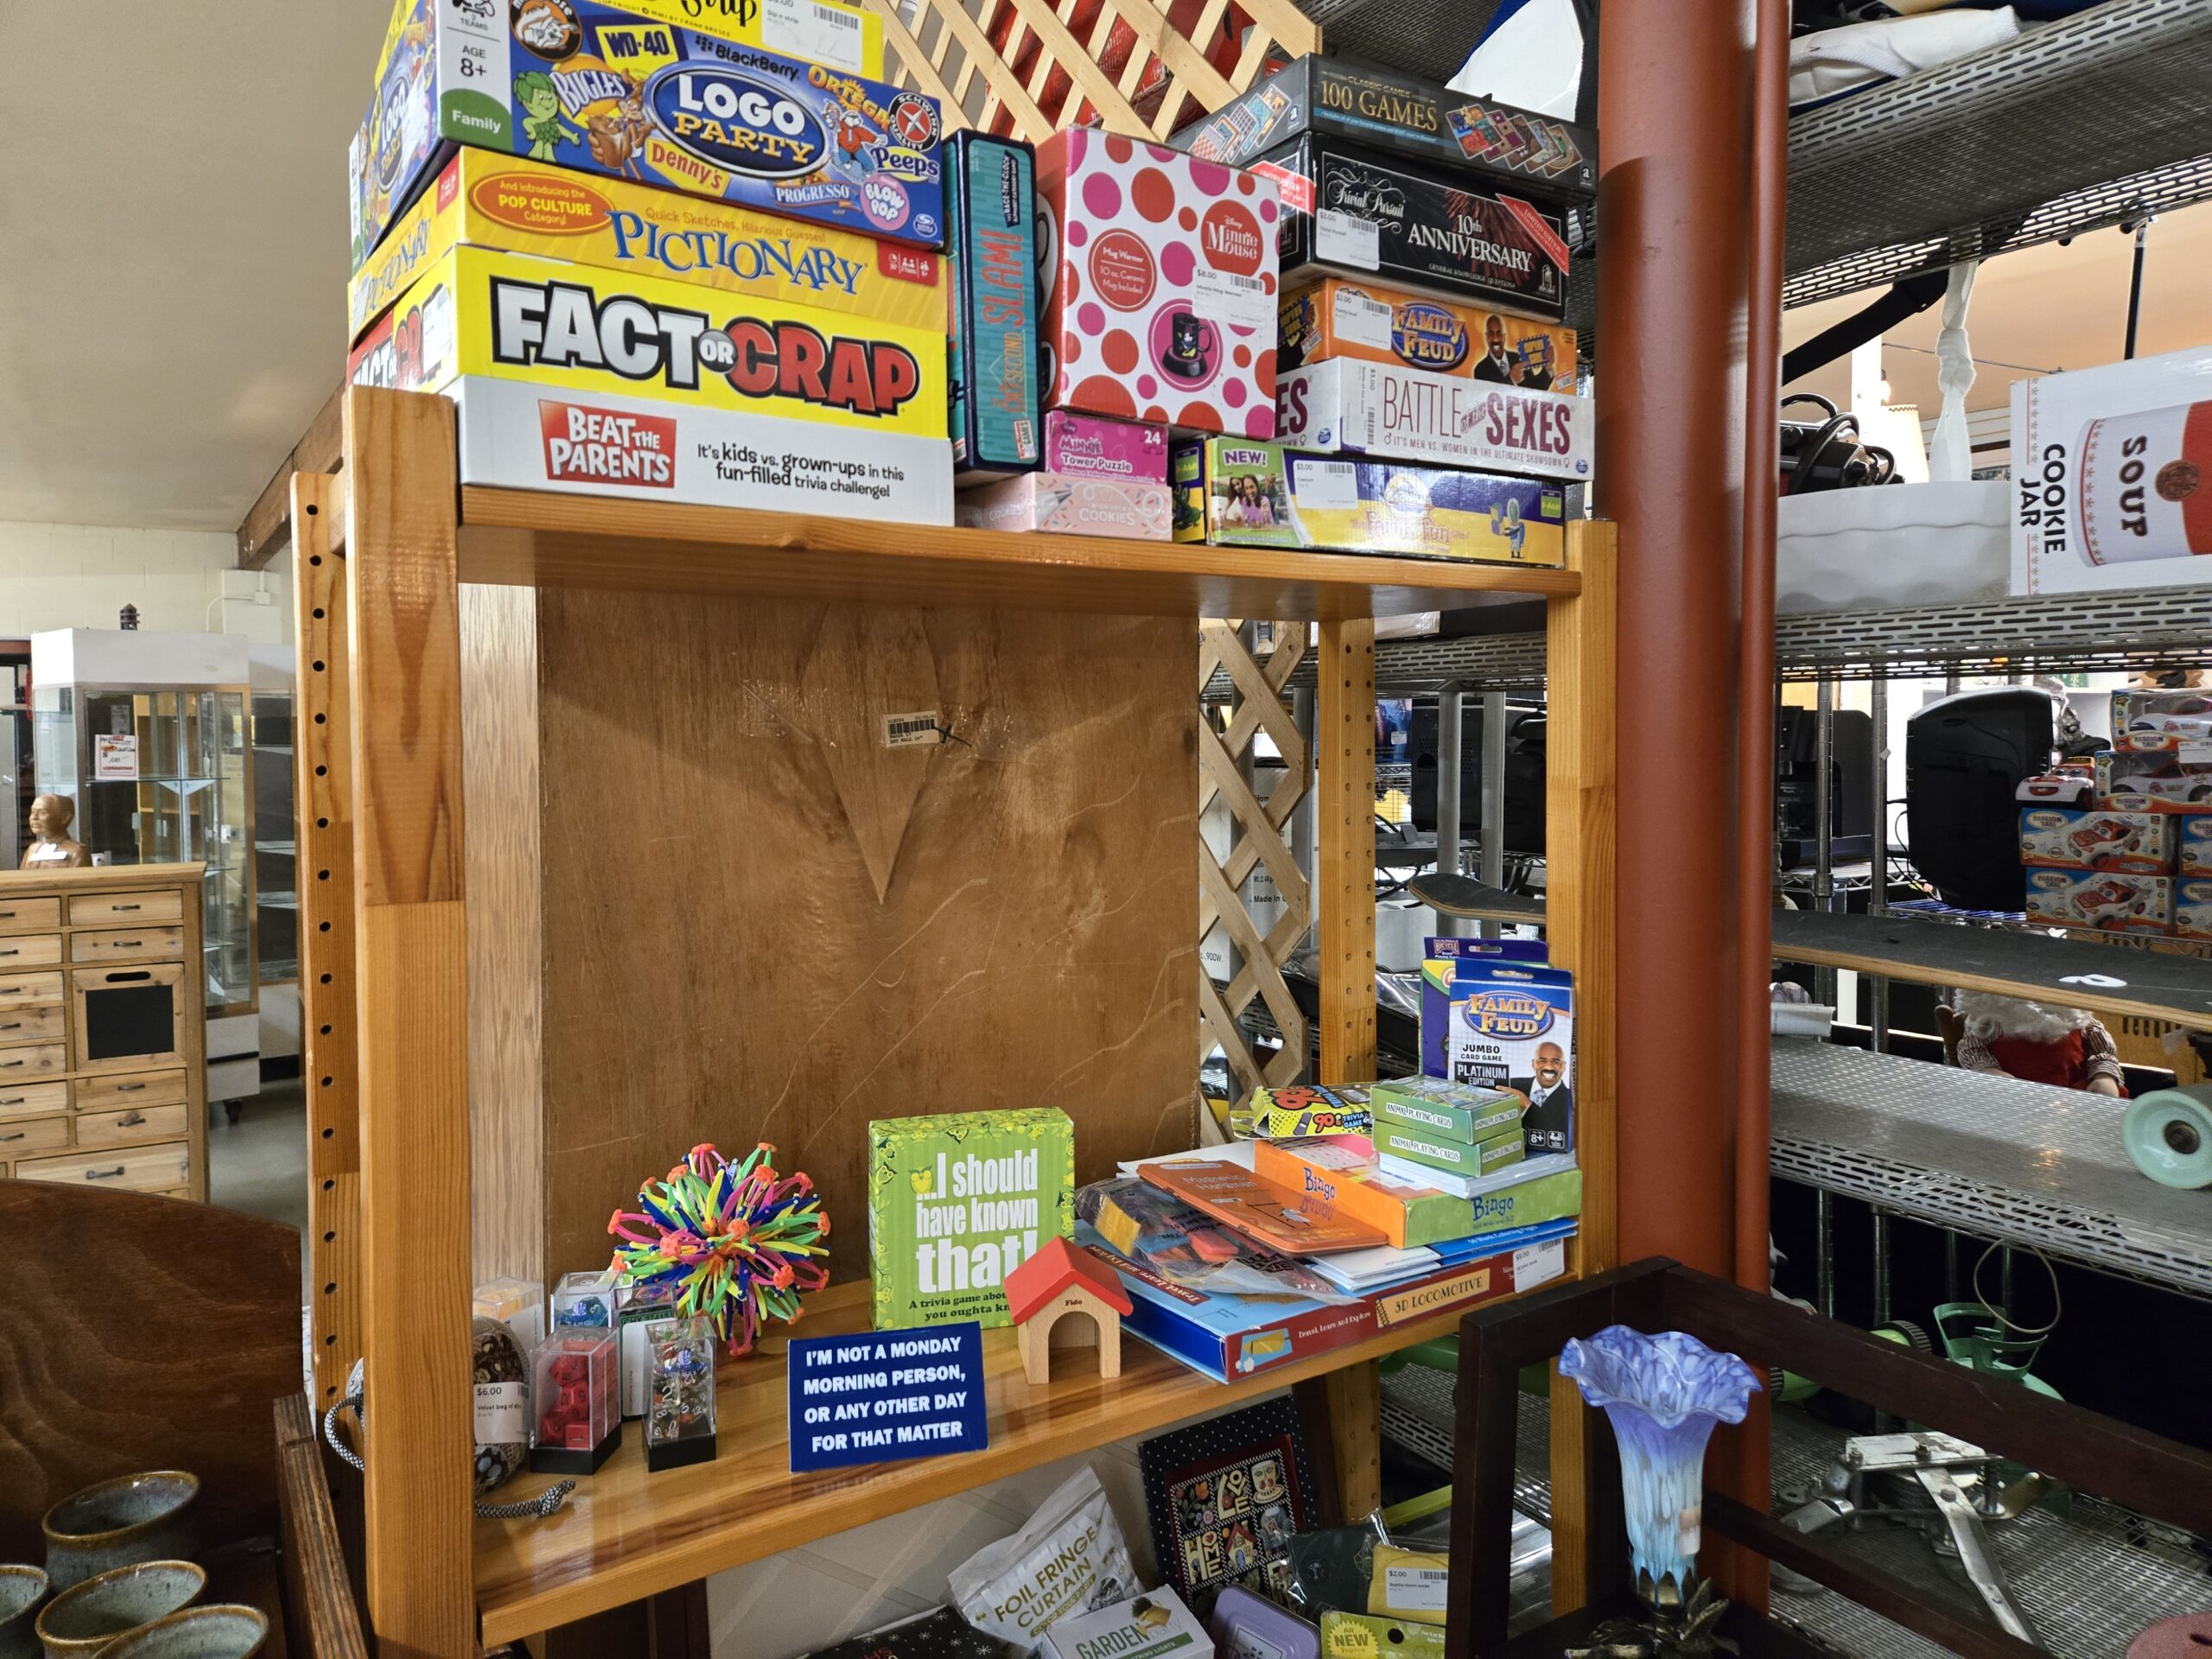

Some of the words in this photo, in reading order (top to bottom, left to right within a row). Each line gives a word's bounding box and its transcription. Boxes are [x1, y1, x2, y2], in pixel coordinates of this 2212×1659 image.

[460, 17, 488, 31] TEAMS
[462, 45, 486, 59] AGE
[604, 30, 672, 58] WD-40
[461, 58, 487, 78] 8+
[715, 44, 799, 81] BlackBerry
[549, 69, 626, 118] BUGLES
[679, 73, 805, 136] LOGO
[808, 65, 891, 131] ORTEGA
[1321, 79, 1353, 111] 100
[1358, 90, 1438, 131] GAMES
[452, 110, 501, 135] Family
[898, 92, 938, 137] SCHWINN
[672, 111, 815, 164] PARTY
[890, 113, 925, 151] QUALITY
[652, 142, 723, 190] Denny's
[869, 146, 941, 176] Peeps
[499, 180, 517, 192] And
[519, 182, 569, 199] Introducing
[571, 188, 586, 199] the
[776, 183, 850, 204] PROGRESSO
[865, 182, 906, 208] BLOW
[1327, 179, 1368, 208] Trivial
[1367, 188, 1406, 219] Pursuit
[498, 194, 528, 208] POP
[531, 198, 593, 216] CULTURE
[524, 211, 567, 226] Category!
[871, 200, 899, 222] POP
[645, 207, 679, 222] Quick
[683, 213, 740, 232] Sketches,
[742, 220, 783, 237] Hilarious
[785, 227, 826, 243] Guesses!
[1457, 213, 1483, 237] 10th
[606, 210, 863, 296] PICTIONARY
[1103, 246, 1118, 259] Mug
[1118, 250, 1144, 264] Warmer
[1408, 222, 1532, 273] ANNIVERSARY
[978, 229, 1025, 327] SLAM!
[1100, 265, 1110, 276] 10
[1120, 270, 1146, 283] Ceramic
[1103, 278, 1117, 291] Mug
[1118, 281, 1143, 295] Included
[1197, 268, 1217, 280] $8.00
[1428, 263, 1453, 275] GENERAL
[1454, 269, 1486, 283] KNOWLEDGE
[1336, 293, 1352, 304] $2.00
[1392, 304, 1466, 344] FAMILY
[491, 276, 709, 391] FACT
[700, 333, 735, 372] OR
[724, 318, 920, 416] CRAP
[1002, 331, 1024, 382] SECOND
[1403, 329, 1455, 362] FEUD
[567, 407, 637, 445] BEAT
[632, 430, 661, 451] THE
[1383, 376, 1462, 438] BATTLE
[1485, 391, 1571, 455] SEXES
[1144, 429, 1161, 444] 24
[550, 442, 671, 483] PARENTS
[697, 443, 720, 461] It's
[722, 443, 757, 465] kids
[760, 454, 779, 467] vs.
[781, 453, 865, 480] grown-ups
[868, 466, 880, 478] in
[881, 466, 905, 481] this
[1062, 453, 1095, 467] Tower
[1098, 460, 1132, 473] Puzzle
[1224, 449, 1268, 467] NEW!
[1393, 436, 1408, 447] IT'S
[1410, 438, 1426, 449] MEN
[1427, 441, 1440, 452] VS.
[1442, 442, 1468, 454] WOMEN
[1471, 446, 1478, 456] IN
[1480, 447, 1492, 458] THE
[1494, 449, 1524, 461] ULTIMATE
[1526, 453, 1562, 467] SHOWDOWN
[716, 461, 791, 487] fun-filled
[794, 475, 828, 491] trivia
[830, 479, 890, 499] challenge!
[2119, 435, 2148, 537] SOUP
[2019, 478, 2041, 527] JAR
[2043, 443, 2066, 554] COOKIE
[1079, 507, 1136, 526] COOKIES
[1435, 942, 1459, 951] BICYCLE
[1470, 995, 1550, 1020] FAMILY
[1479, 1011, 1539, 1035] FEUD
[1462, 1043, 1501, 1054] JUMBO
[1457, 1064, 1507, 1079] PLATINUM
[1468, 1077, 1496, 1087] EDITION
[1342, 1113, 1365, 1122] TRIVIA
[1344, 1120, 1363, 1128] GAME
[1387, 1103, 1408, 1116] ANIMAL
[1408, 1109, 1433, 1122] PLAYING
[1433, 1115, 1452, 1128] CARDS
[1390, 1136, 1413, 1149] ANIMAL
[1413, 1142, 1439, 1156] PLAYING
[1440, 1148, 1460, 1162] CARDS
[1530, 1133, 1544, 1143] 8+
[951, 1148, 1038, 1198] should
[1303, 1166, 1337, 1200] Bingo
[916, 1202, 967, 1238] have
[971, 1197, 1039, 1234] known
[1471, 1195, 1515, 1222] Bingo
[916, 1230, 1038, 1294] that!
[908, 1300, 918, 1310] A
[920, 1296, 951, 1308] trivia
[953, 1295, 982, 1309] game
[982, 1291, 1007, 1304] abou
[1065, 1298, 1083, 1306] Fido
[1395, 1300, 1408, 1313] 3D
[1411, 1276, 1484, 1307] LOCOMOTIVE
[925, 1309, 948, 1321] you
[950, 1305, 994, 1319] oughta
[1299, 1325, 1319, 1338] Travel,
[1319, 1320, 1337, 1333] Learn
[1338, 1319, 1349, 1330] and
[1348, 1311, 1372, 1326] Explore
[806, 1348, 833, 1367] I'M
[836, 1345, 871, 1363] NOT
[874, 1344, 887, 1360] A
[890, 1336, 962, 1358] MONDAY
[476, 1386, 502, 1396] $6.00
[804, 1372, 888, 1395] MORNING
[892, 1364, 967, 1387] PERSON,
[496, 1403, 508, 1412] bag
[804, 1407, 830, 1424] OR
[834, 1402, 871, 1421] ANY
[874, 1395, 931, 1416] OTHER
[934, 1391, 968, 1410] DAY
[811, 1433, 848, 1452] FOR
[851, 1428, 893, 1448] THAT
[897, 1421, 963, 1443] MATTER
[1217, 1470, 1251, 1521] LOVE
[1184, 1530, 1224, 1586] HOME
[994, 1581, 1038, 1623] FOIL
[1035, 1526, 1097, 1591] FRINGE
[1389, 1569, 1408, 1578] $2.00
[1017, 1556, 1093, 1628] CURTAIN
[1076, 1623, 1151, 1659] GARDEN
[1154, 1642, 1175, 1656] LIGHTS
[1333, 1633, 1370, 1647] NEW
